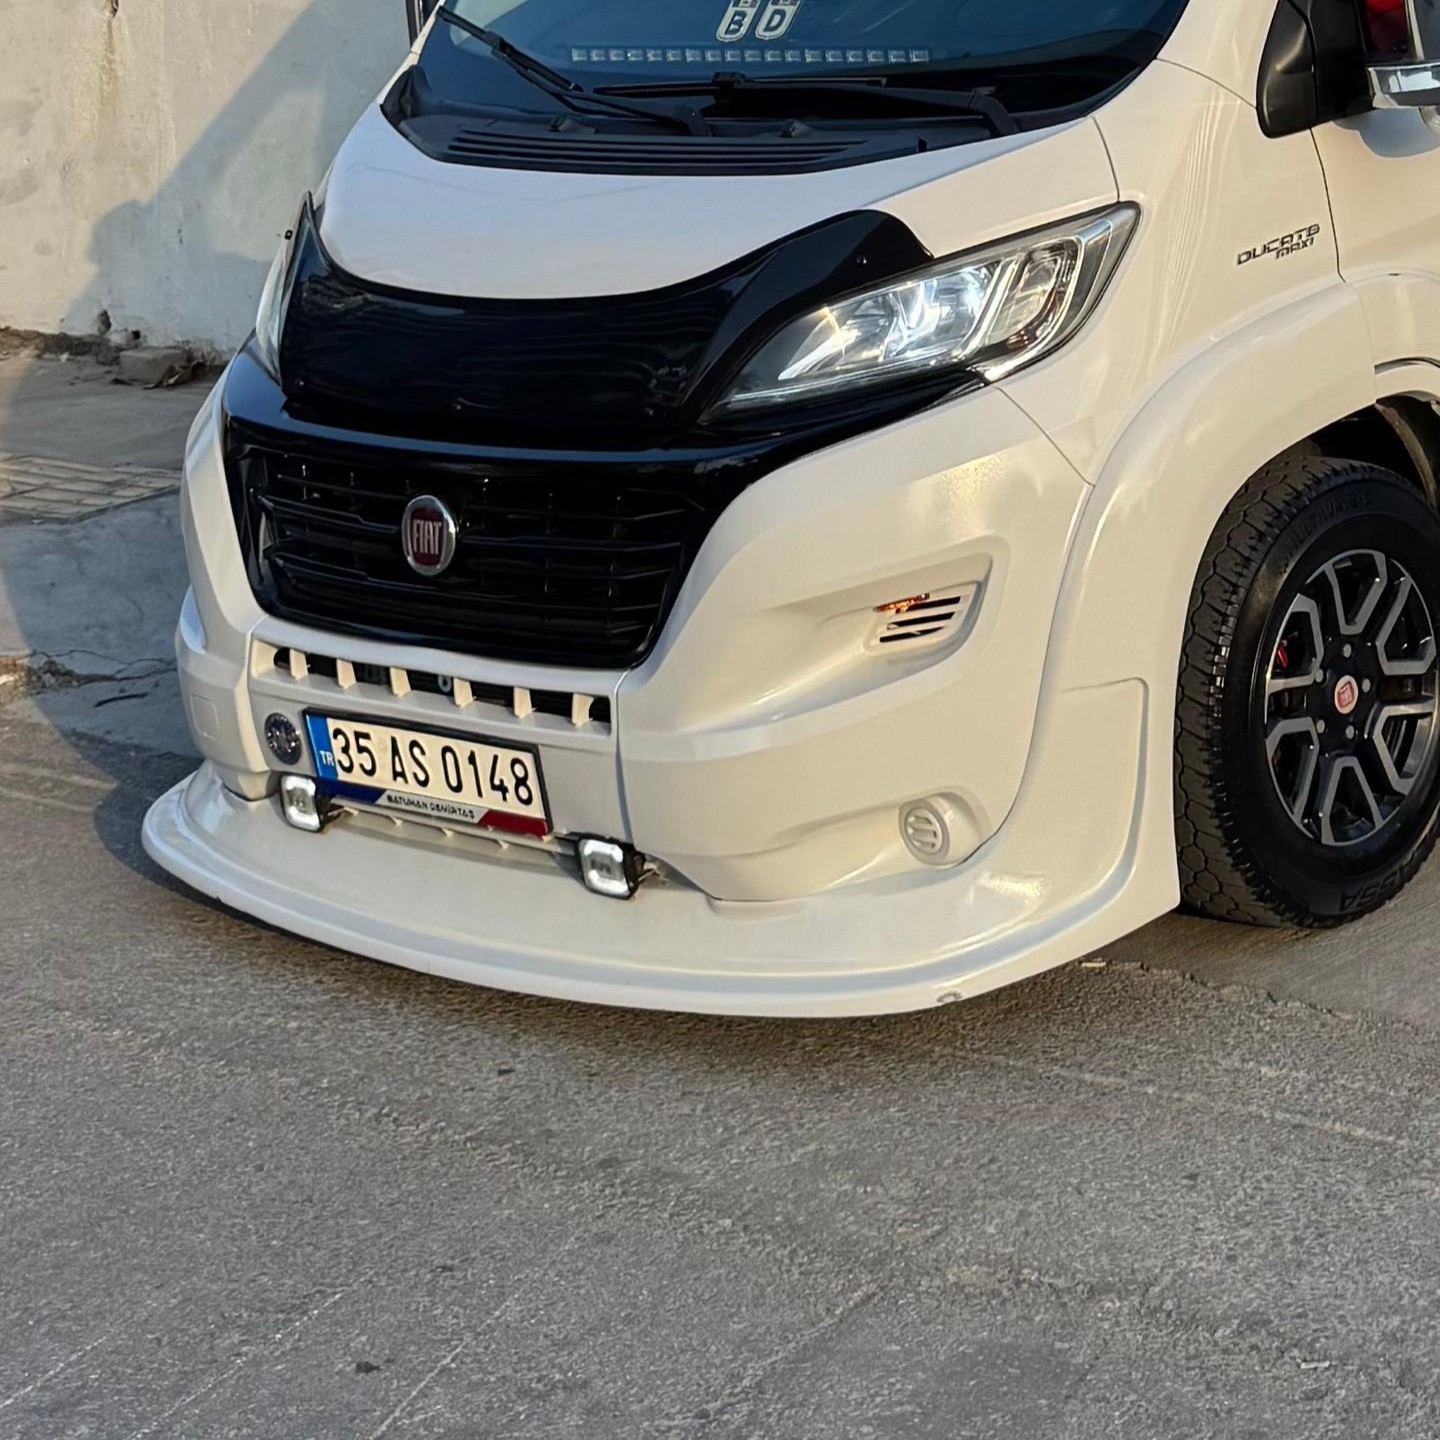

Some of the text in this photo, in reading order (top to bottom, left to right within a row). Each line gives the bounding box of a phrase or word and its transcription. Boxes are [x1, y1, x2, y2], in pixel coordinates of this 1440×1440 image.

[724, 9, 787, 36] B D
[1236, 223, 1321, 265] DUCATO
[1275, 237, 1315, 260] MAXI
[412, 518, 442, 555] FIAT
[319, 749, 335, 766] TR
[332, 727, 534, 807] 35 AS 0148
